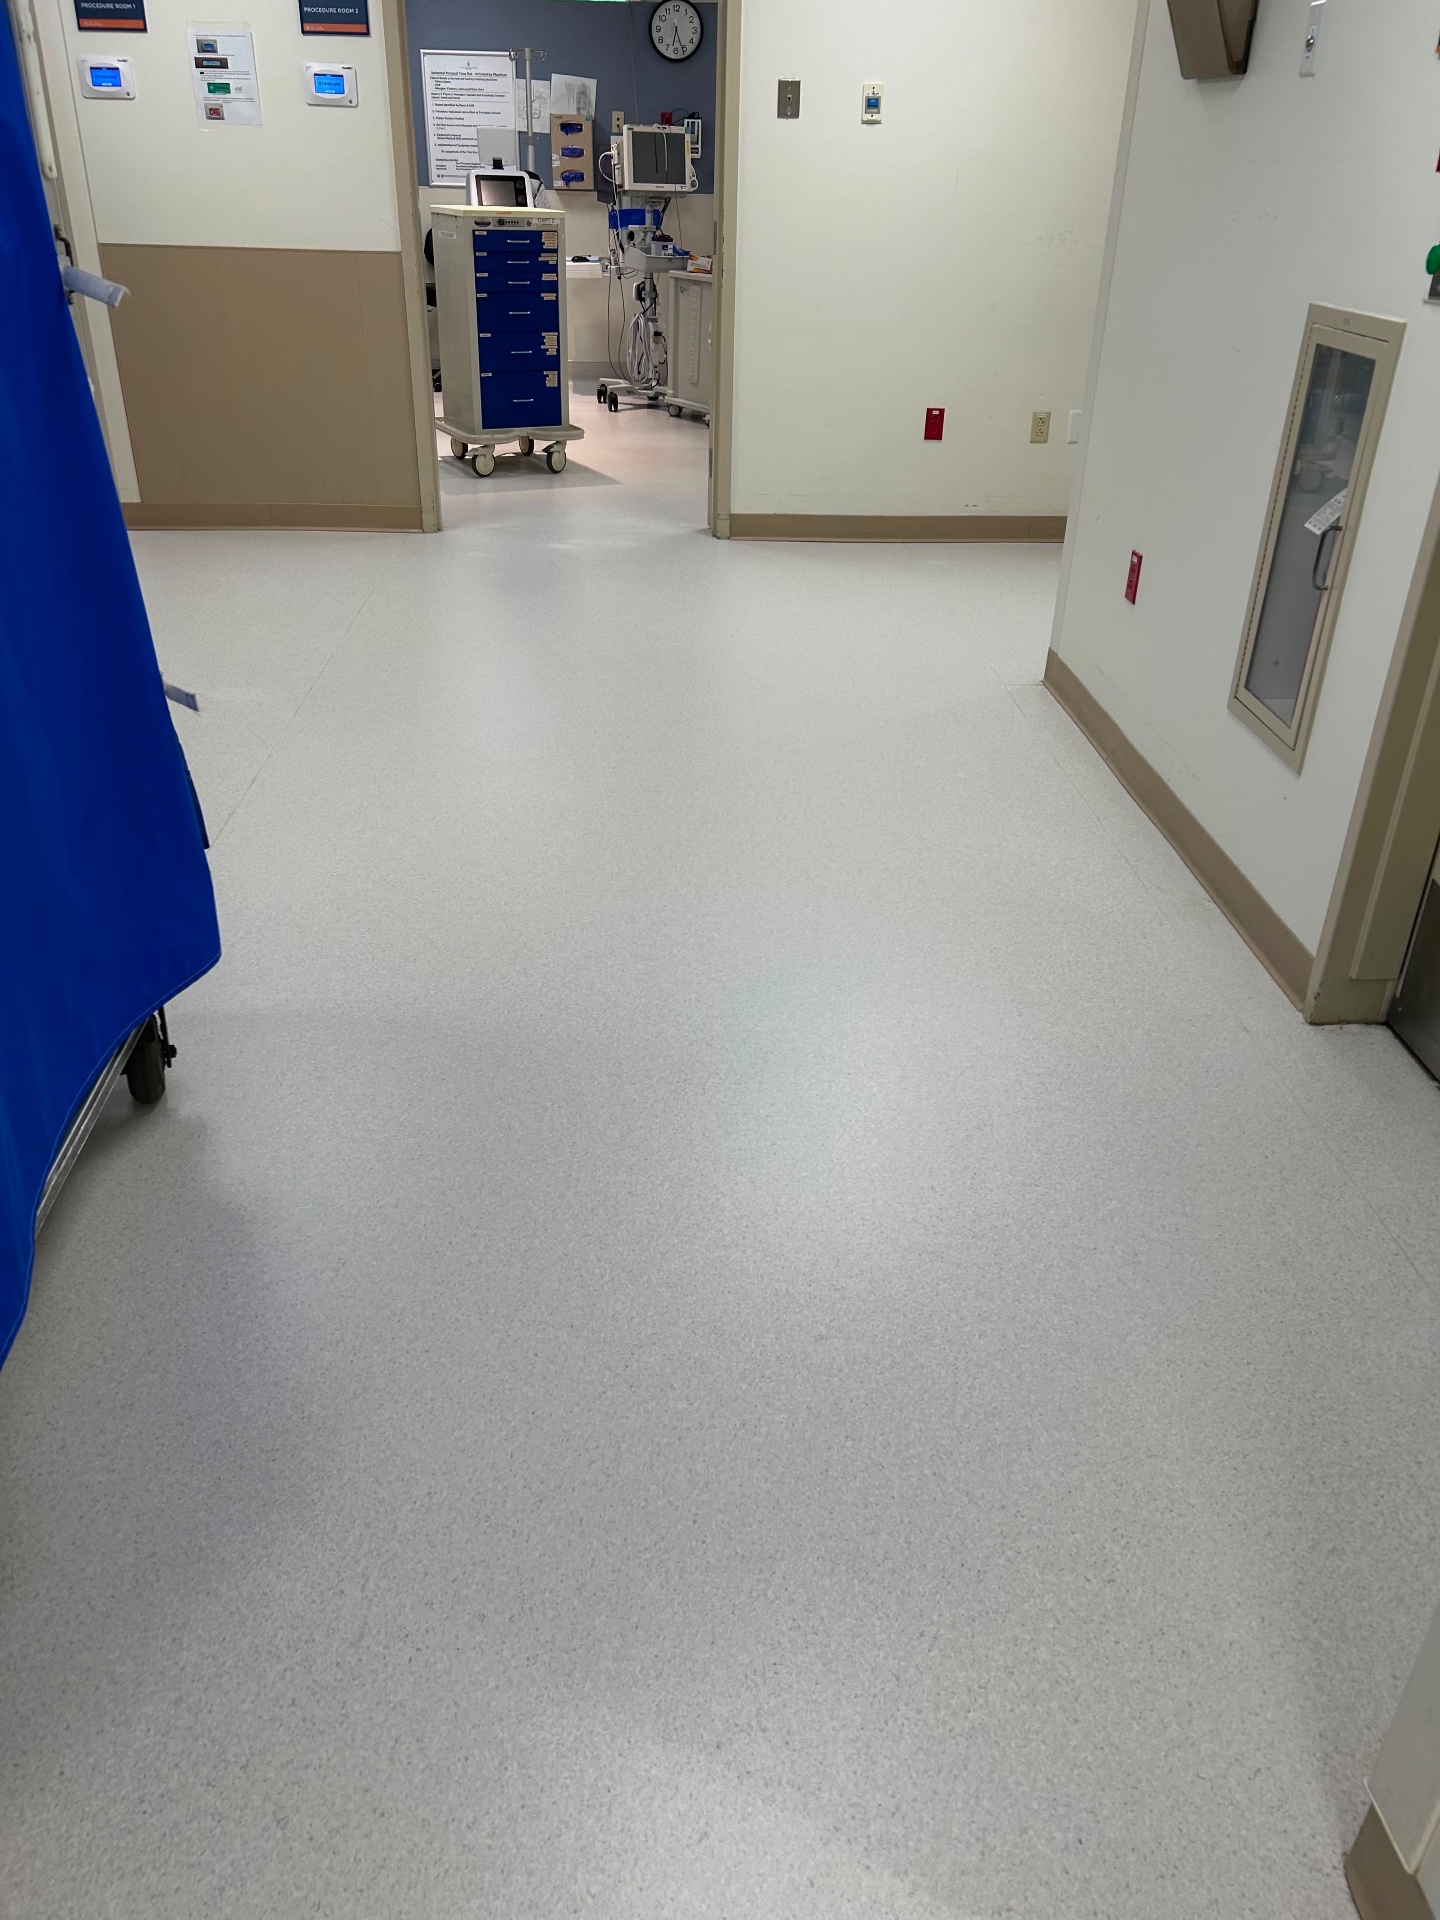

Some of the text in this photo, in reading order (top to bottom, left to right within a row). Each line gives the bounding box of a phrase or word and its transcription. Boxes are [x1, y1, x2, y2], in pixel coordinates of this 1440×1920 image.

[672, 4, 680, 12] 12
[656, 25, 661, 33] 9
[692, 26, 697, 34] 3
[658, 36, 664, 44] 8
